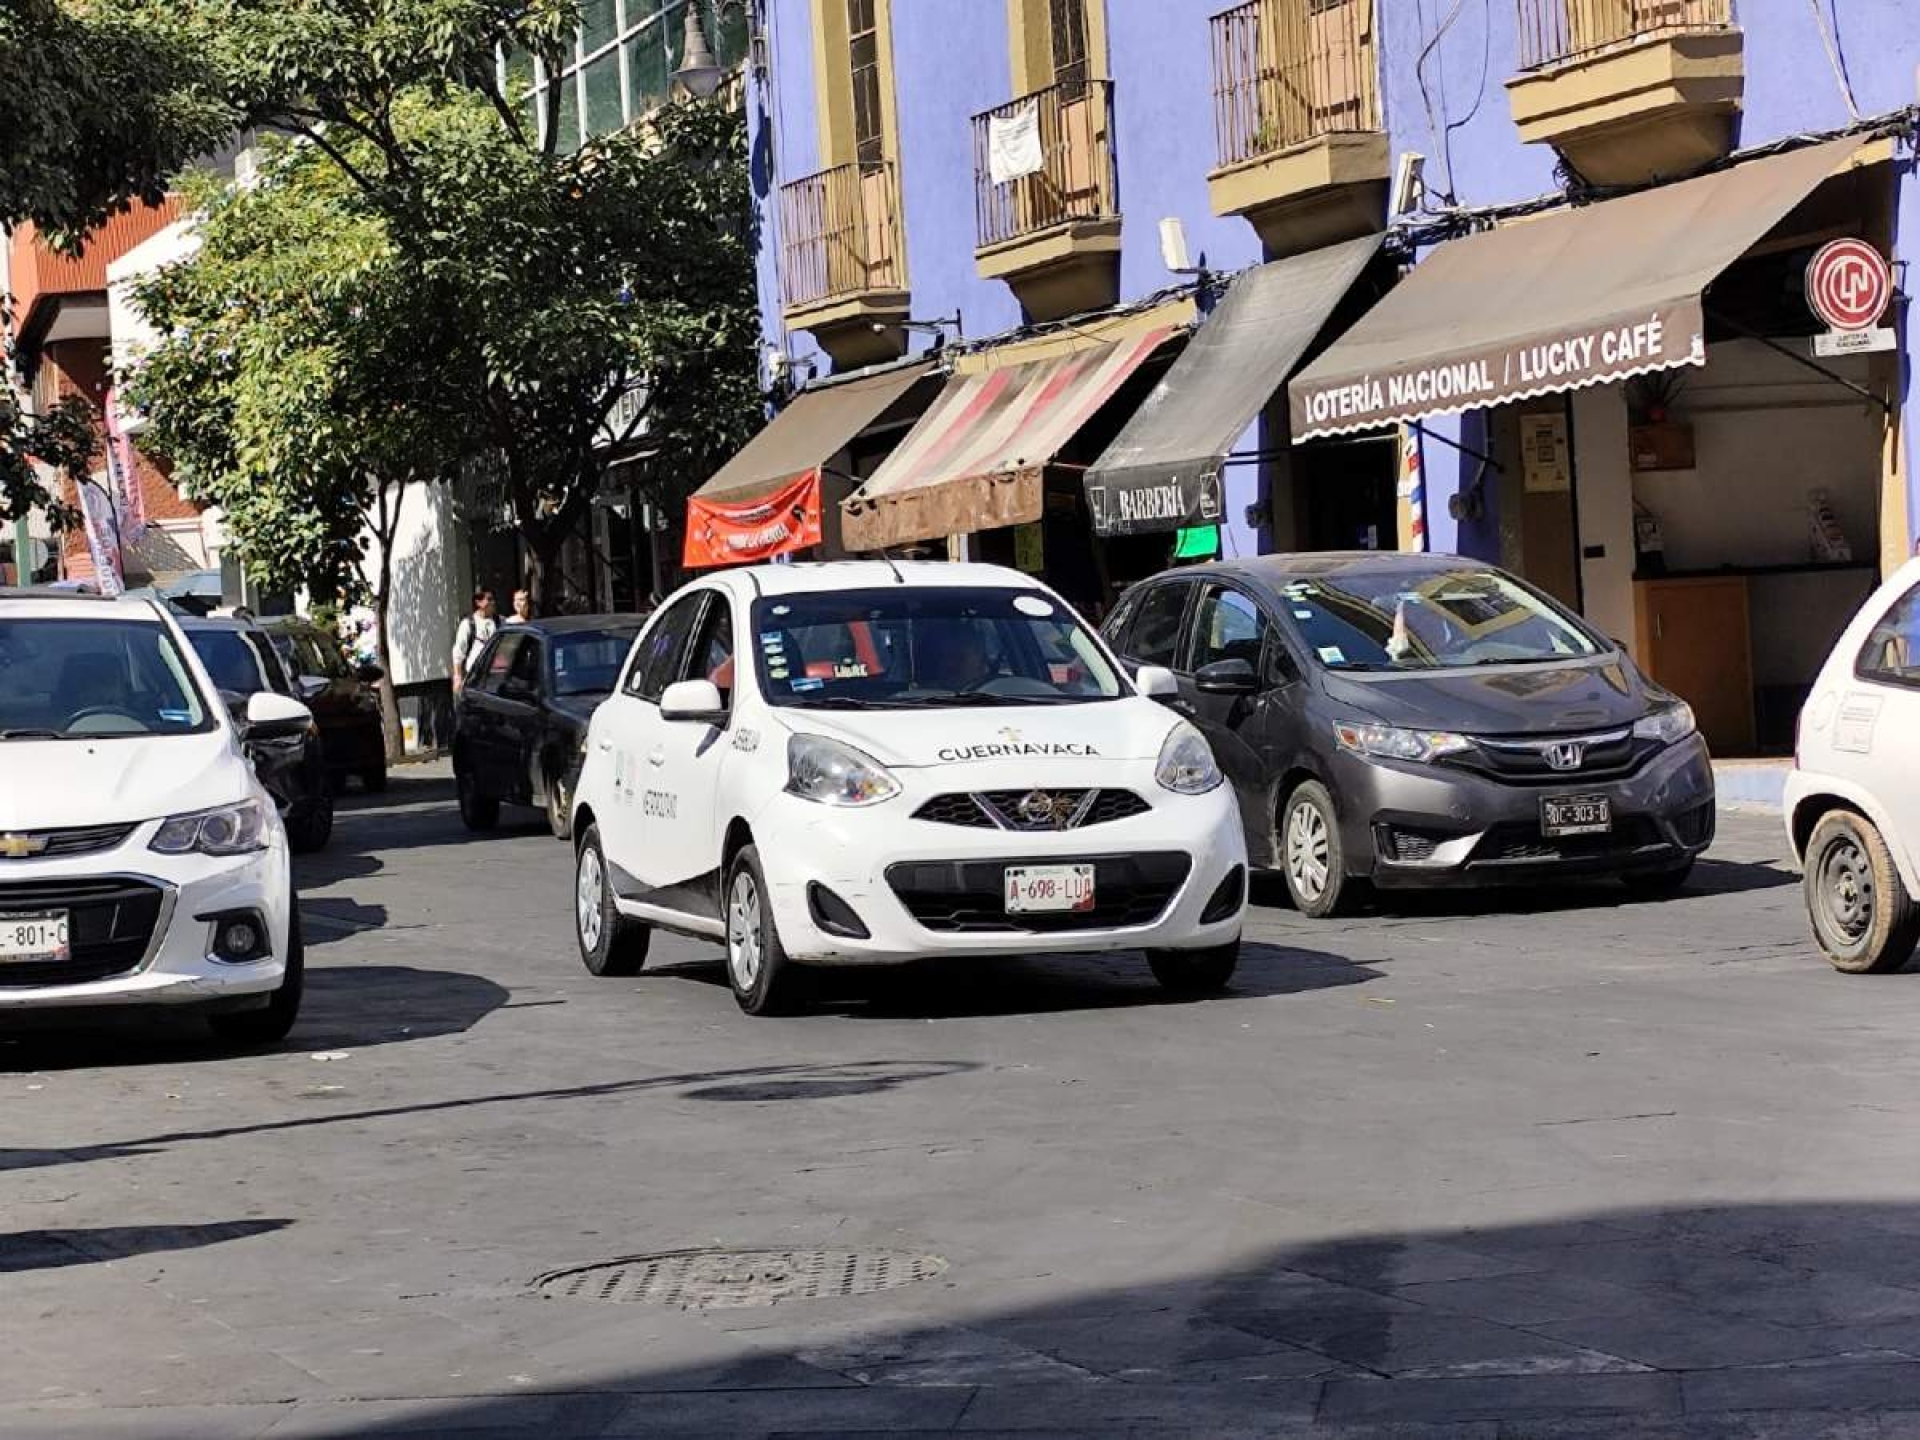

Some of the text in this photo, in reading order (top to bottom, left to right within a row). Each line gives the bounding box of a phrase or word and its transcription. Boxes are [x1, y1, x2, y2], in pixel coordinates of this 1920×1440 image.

[1304, 374, 1385, 424] LOTERÍA
[1388, 359, 1494, 407] NACIONAL
[1503, 352, 1510, 386] /
[1519, 335, 1595, 382] LUCKY
[1601, 312, 1663, 364] CAFÉ
[1119, 475, 1187, 521] BARBERÍA
[938, 743, 1101, 761] CUERNAVACA
[0, 922, 68, 947] -801-C
